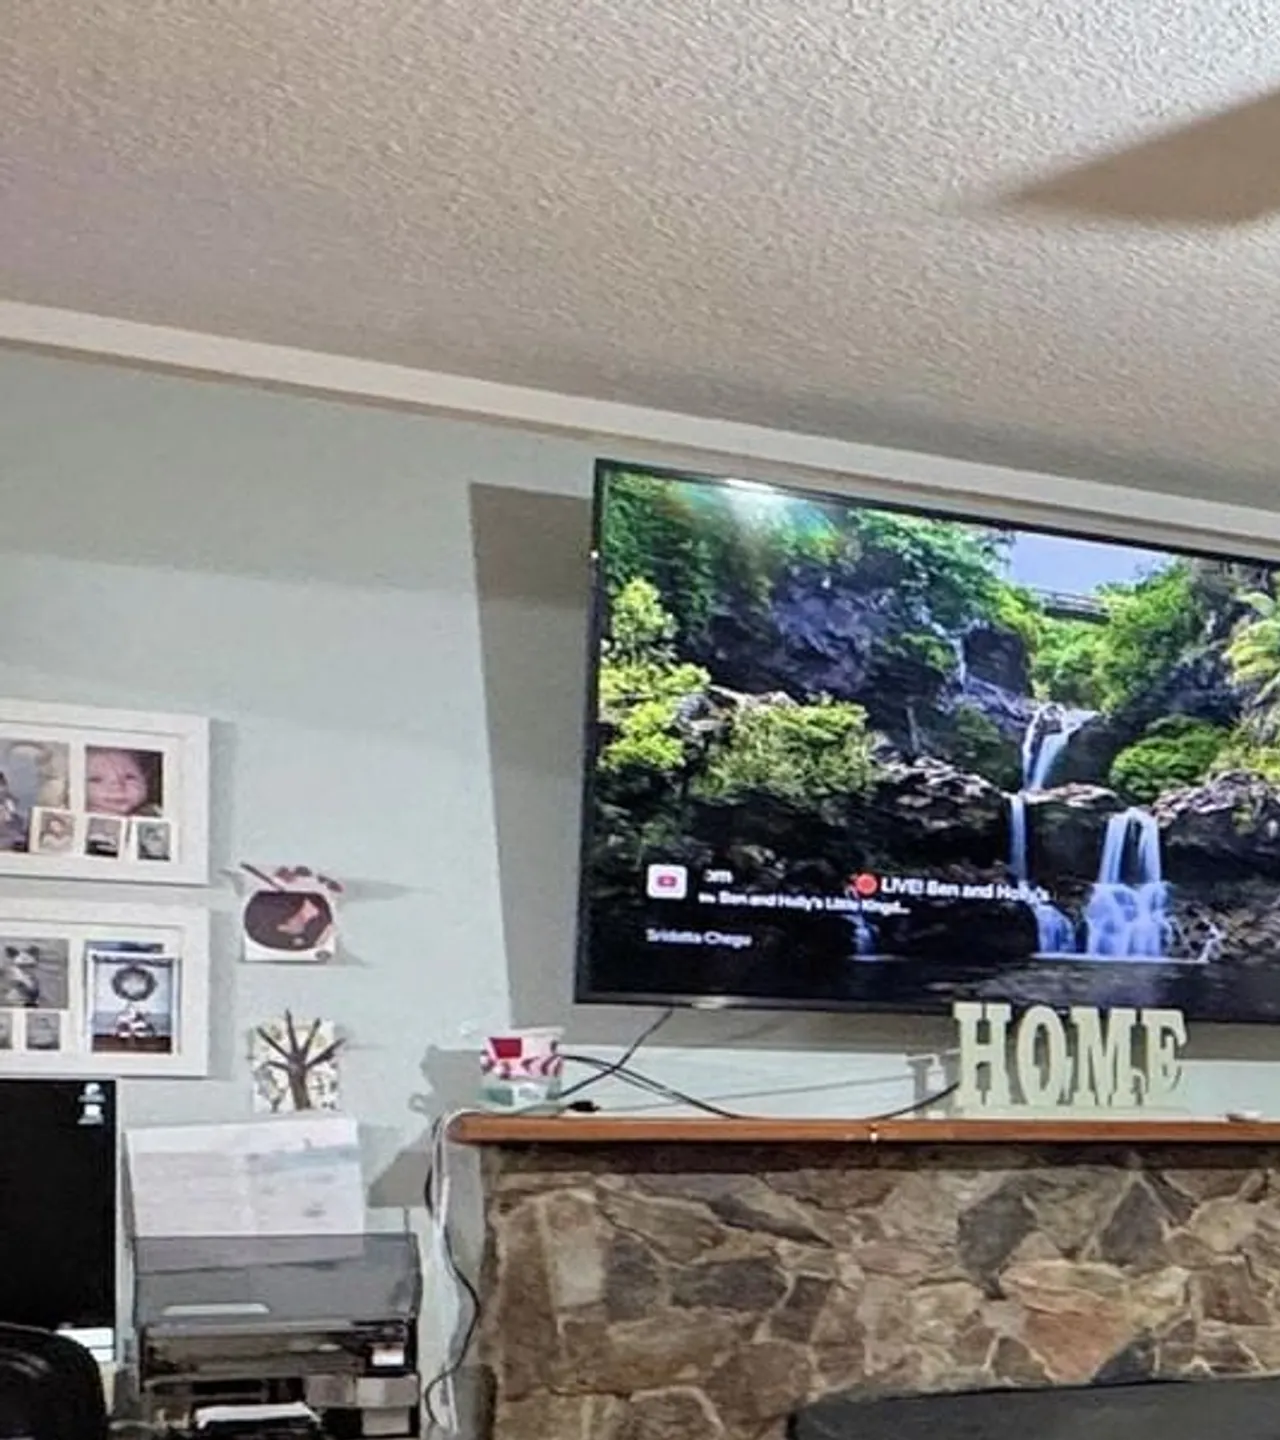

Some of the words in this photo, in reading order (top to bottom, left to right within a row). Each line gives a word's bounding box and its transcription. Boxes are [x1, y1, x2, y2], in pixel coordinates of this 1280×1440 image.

[926, 881, 959, 896] Ben
[962, 883, 994, 899] and
[749, 892, 777, 907] and
[953, 1001, 1188, 1106] HOME
